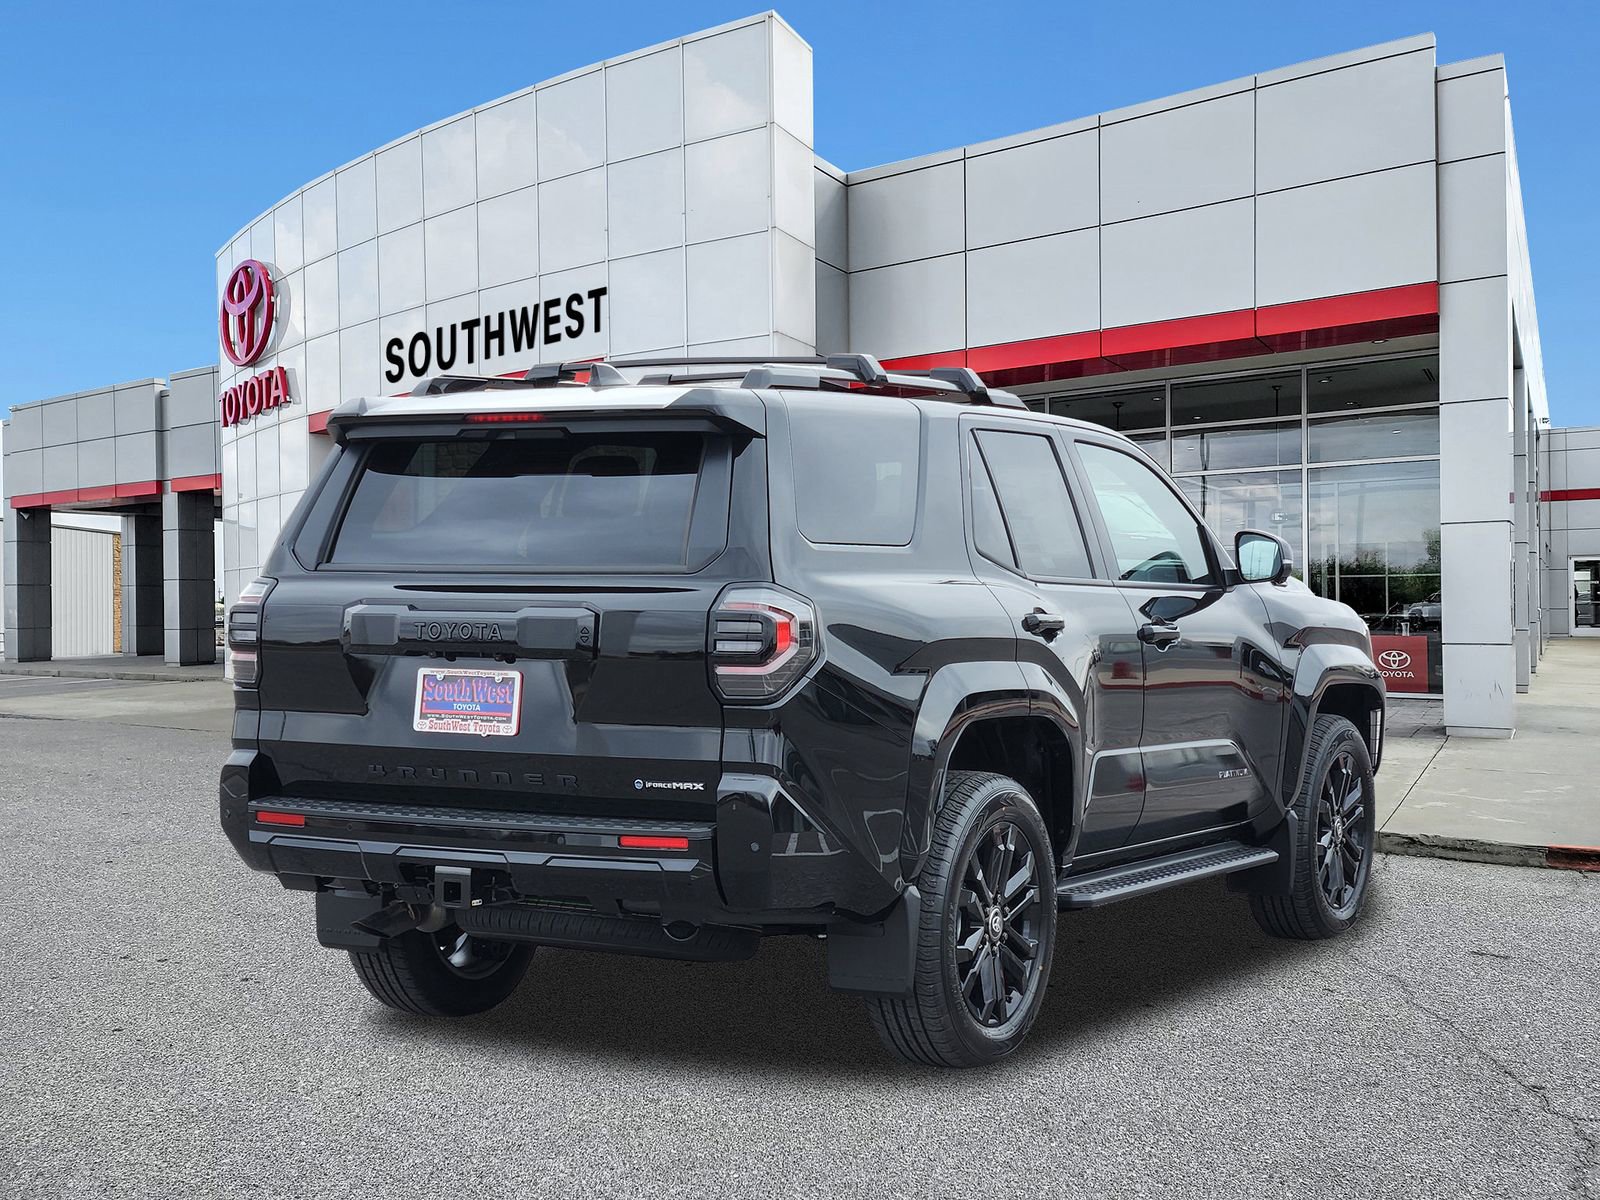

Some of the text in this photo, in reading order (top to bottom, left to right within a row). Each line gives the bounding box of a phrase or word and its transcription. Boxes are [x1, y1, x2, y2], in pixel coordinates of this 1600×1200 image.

[385, 286, 607, 384] SOUTHWEST
[218, 366, 291, 427] TOYOTA
[414, 621, 503, 641] TOYOTA
[453, 703, 481, 711] TOYOTA
[473, 721, 501, 735] Toyota
[368, 764, 579, 788] 4RUNNER
